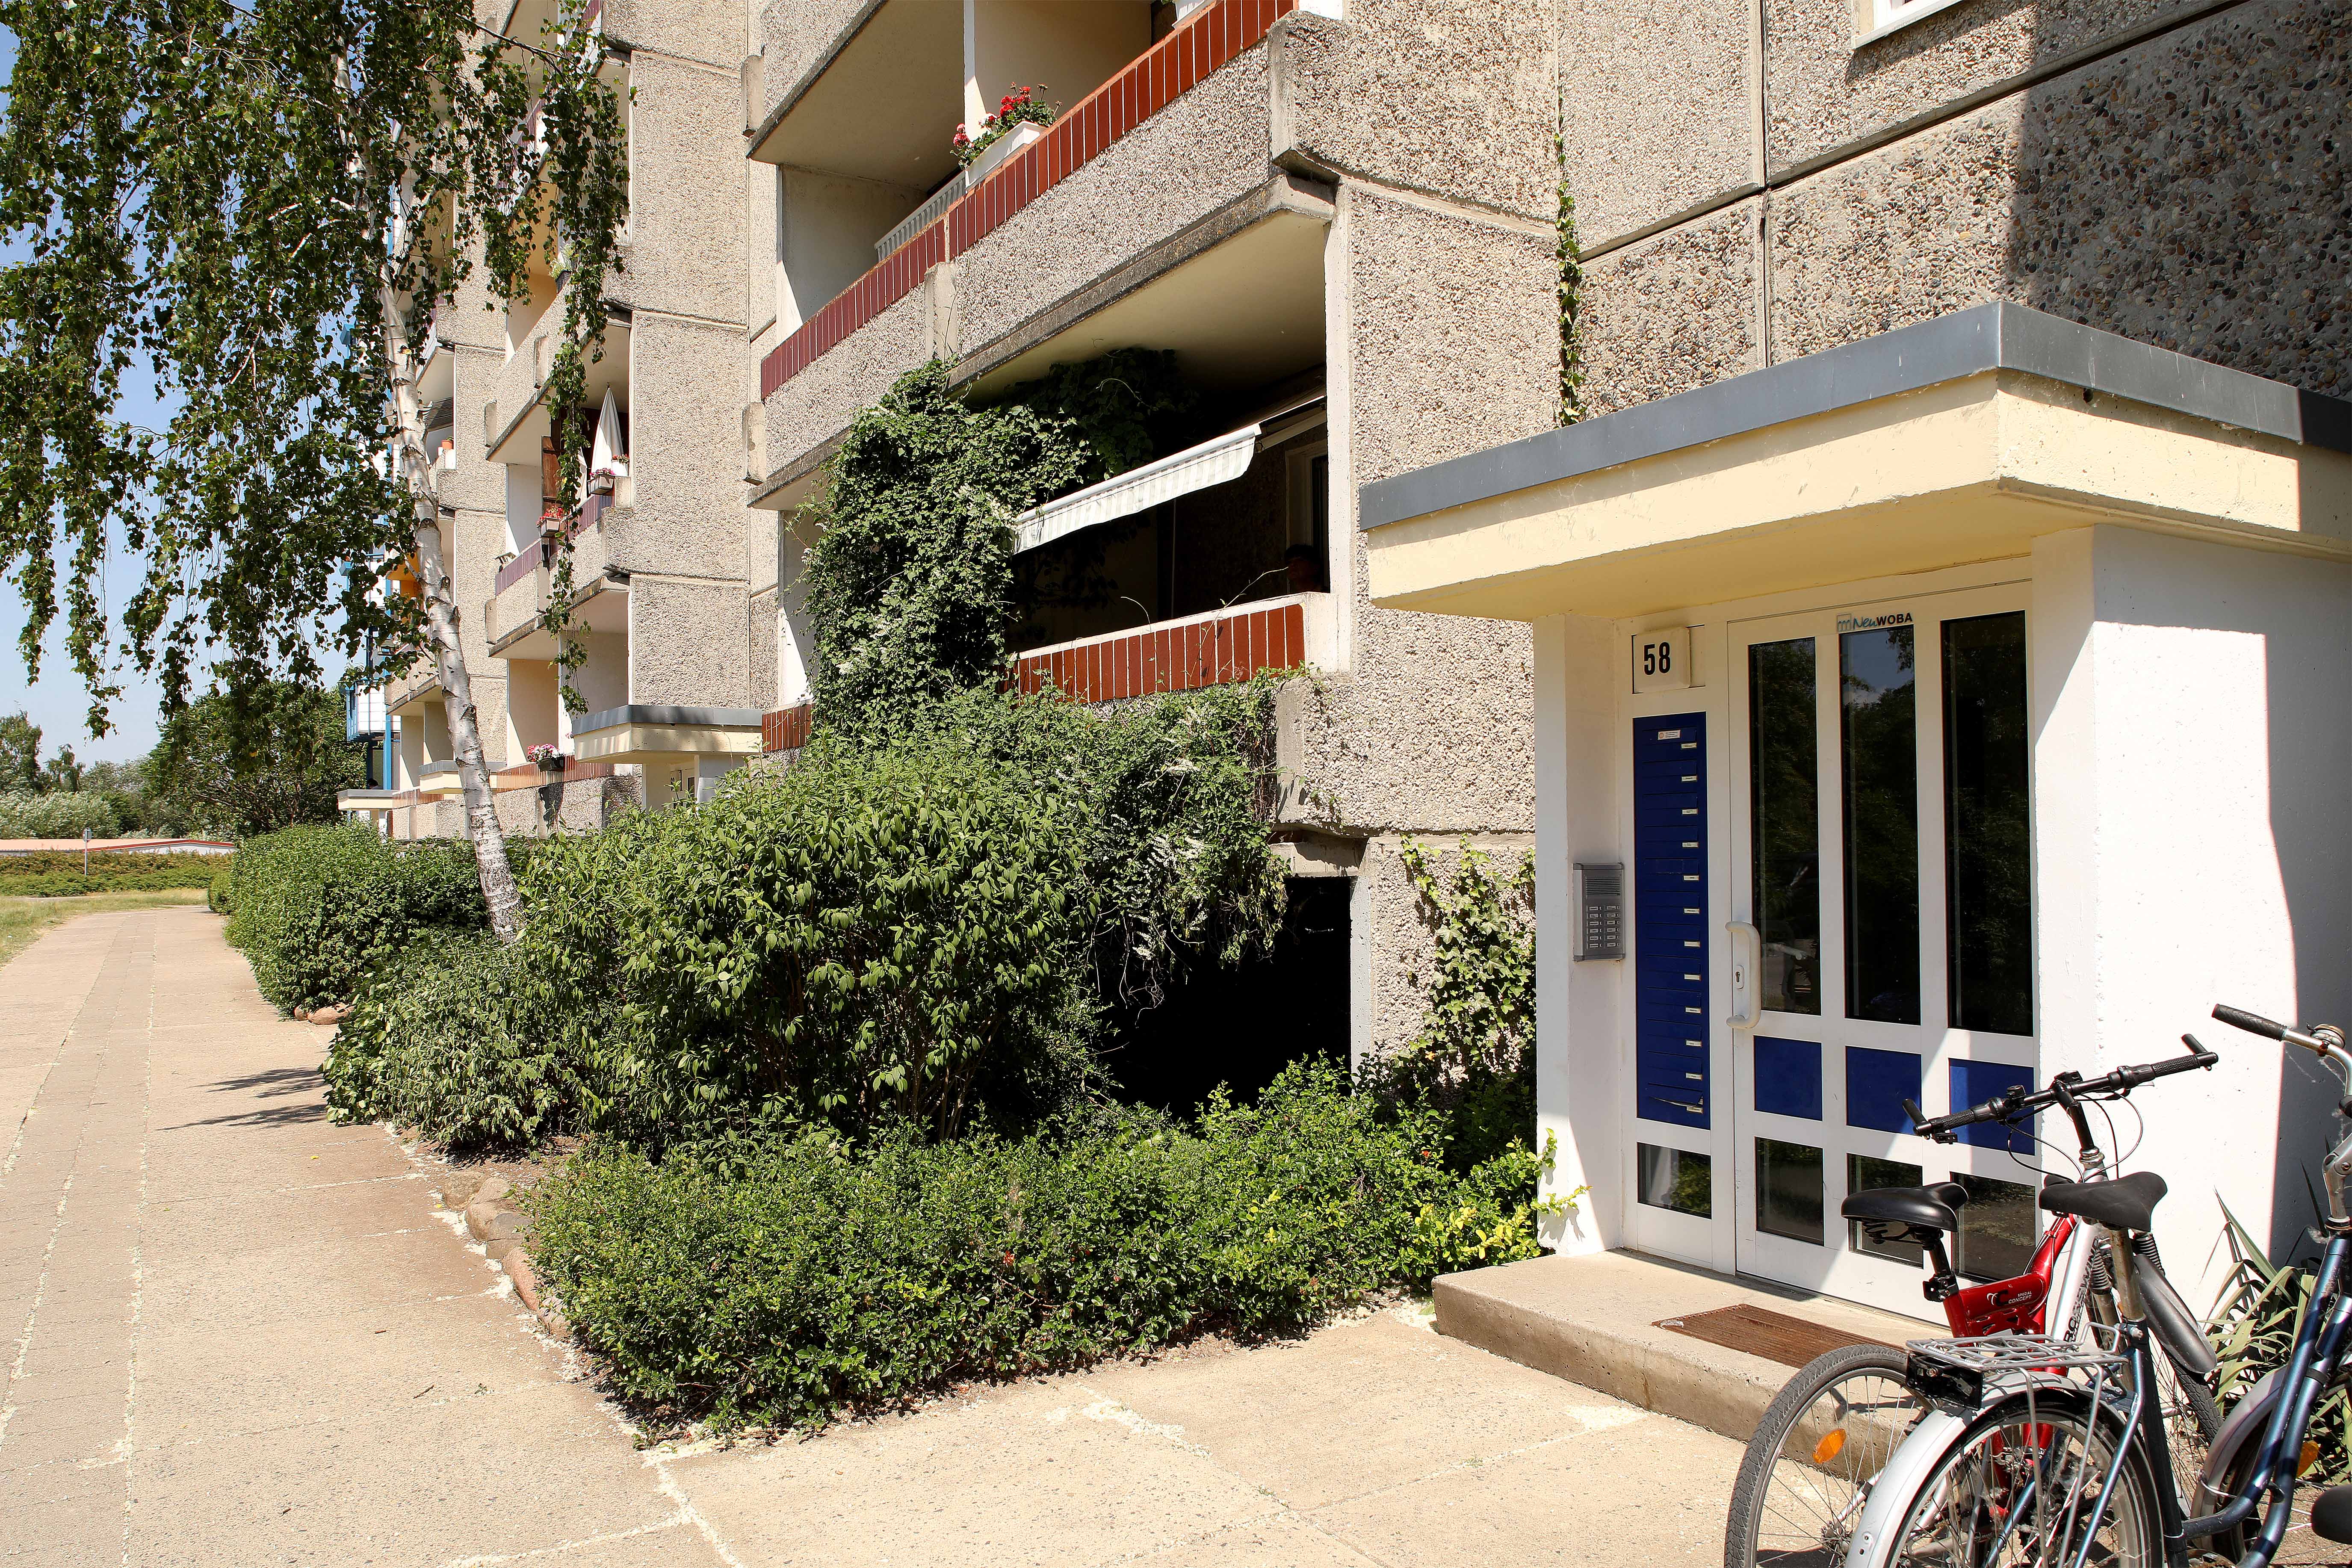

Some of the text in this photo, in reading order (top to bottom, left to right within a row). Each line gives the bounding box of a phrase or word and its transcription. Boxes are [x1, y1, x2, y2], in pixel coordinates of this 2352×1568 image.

[1853, 612, 1913, 630] NeuWOBA
[1643, 642, 1671, 676] 58
[2008, 1294, 2032, 1304] CONCEPT
[2062, 1236, 2099, 1342] ROSSWIND
